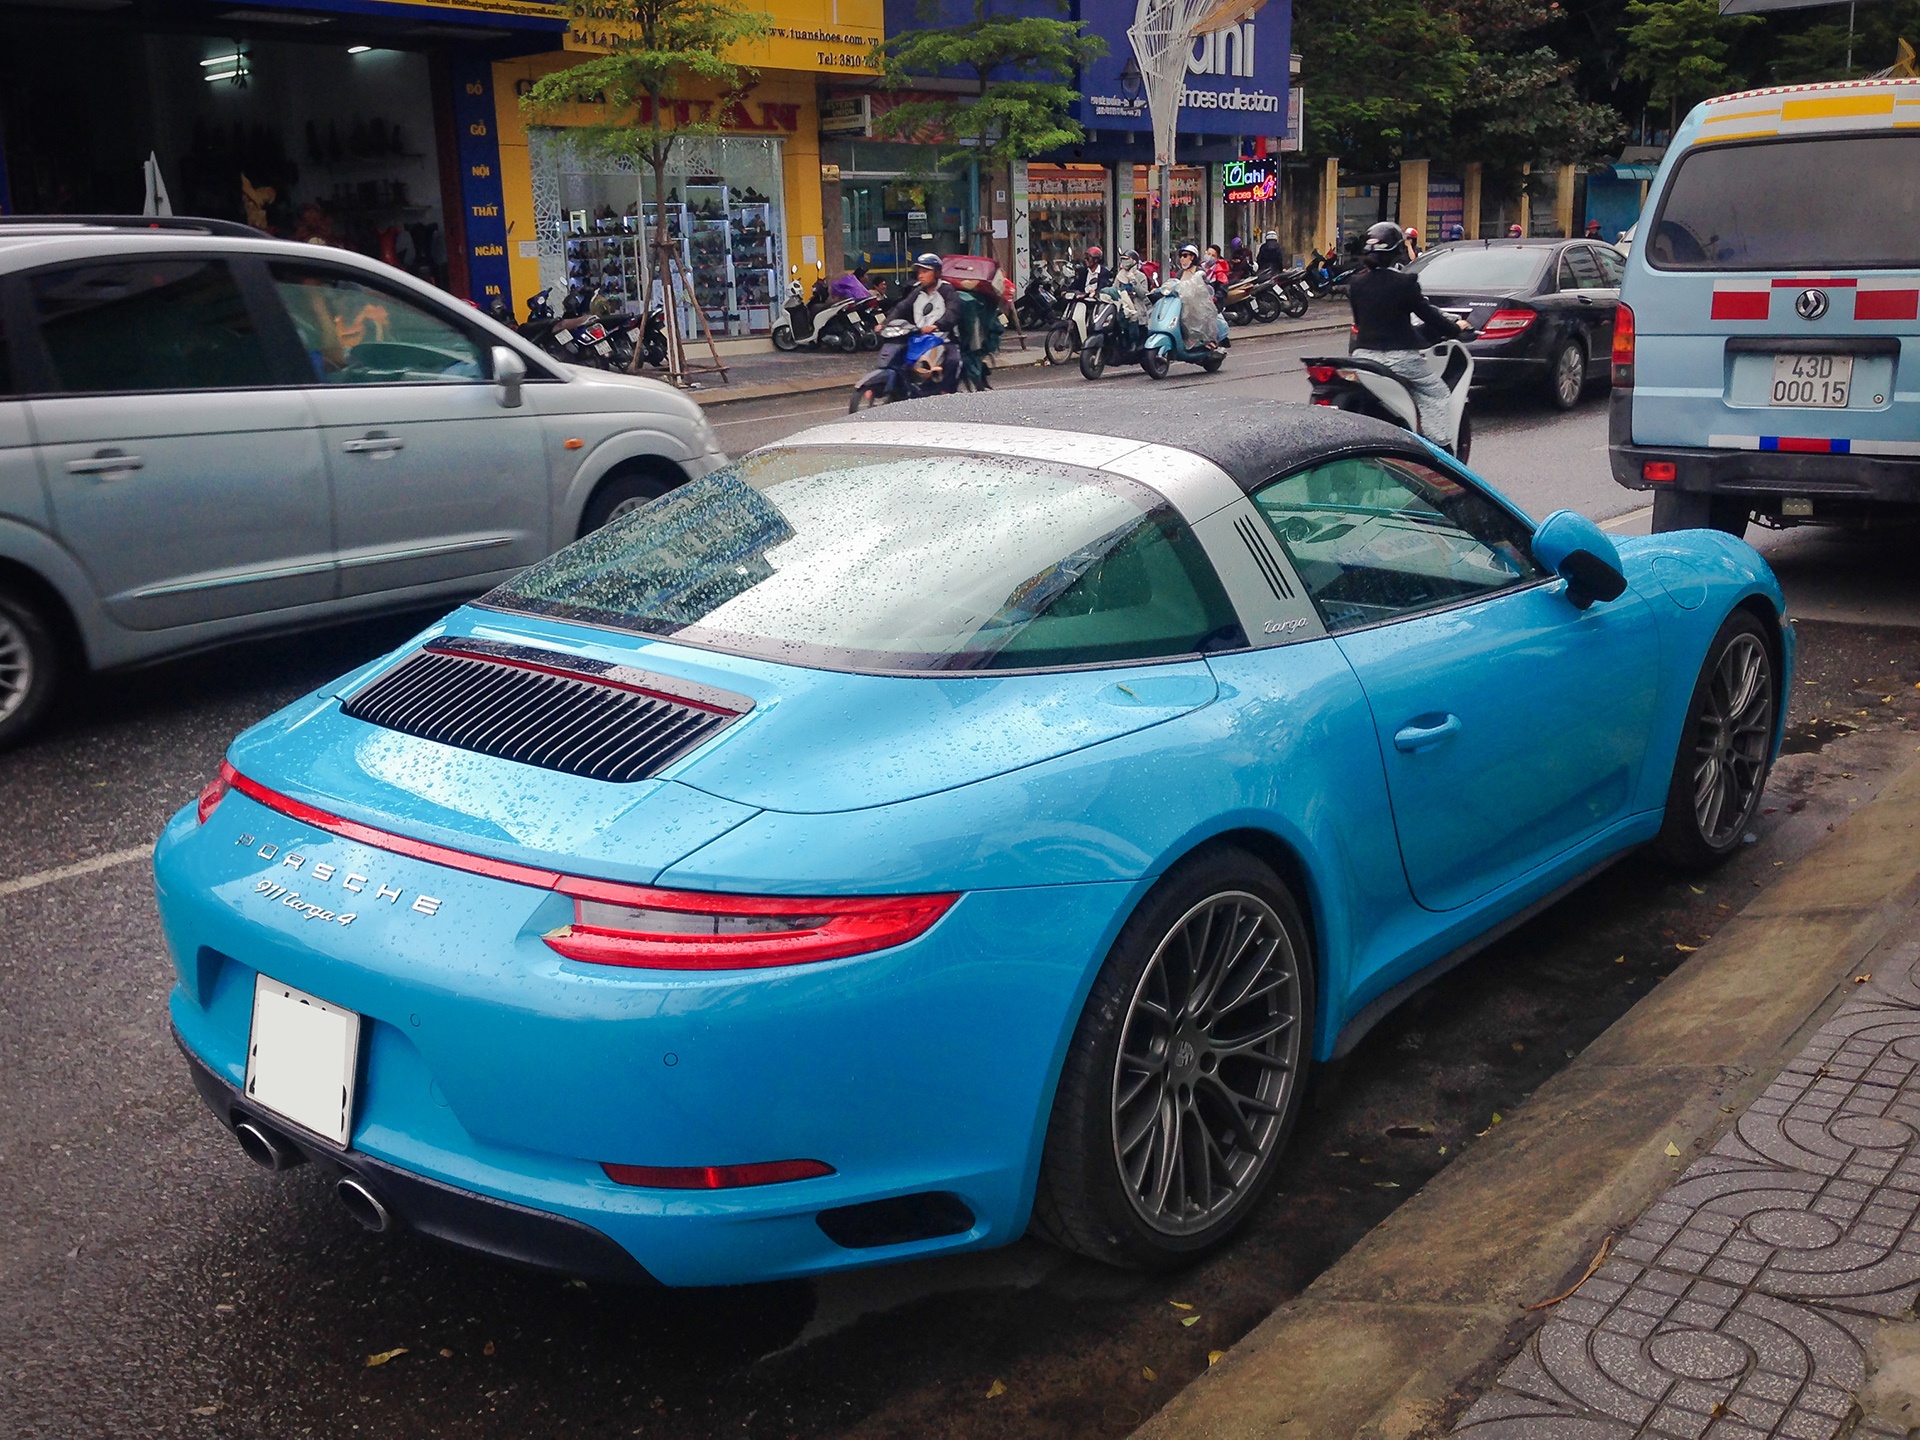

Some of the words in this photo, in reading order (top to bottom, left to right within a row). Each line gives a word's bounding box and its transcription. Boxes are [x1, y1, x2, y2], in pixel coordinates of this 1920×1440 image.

[573, 29, 588, 44] 54
[591, 30, 608, 46] Lê
[816, 51, 837, 66] Tel:
[839, 53, 861, 68] 3810
[1218, 87, 1279, 113] collection
[1228, 191, 1252, 200] shoes
[471, 202, 499, 216] THẤT
[474, 244, 504, 257] NGÂN
[1792, 356, 1833, 379] 43D
[1773, 380, 1846, 404] 000.15
[234, 833, 443, 916] PORSCHE
[254, 879, 288, 900] 911
[336, 912, 358, 926] 4
